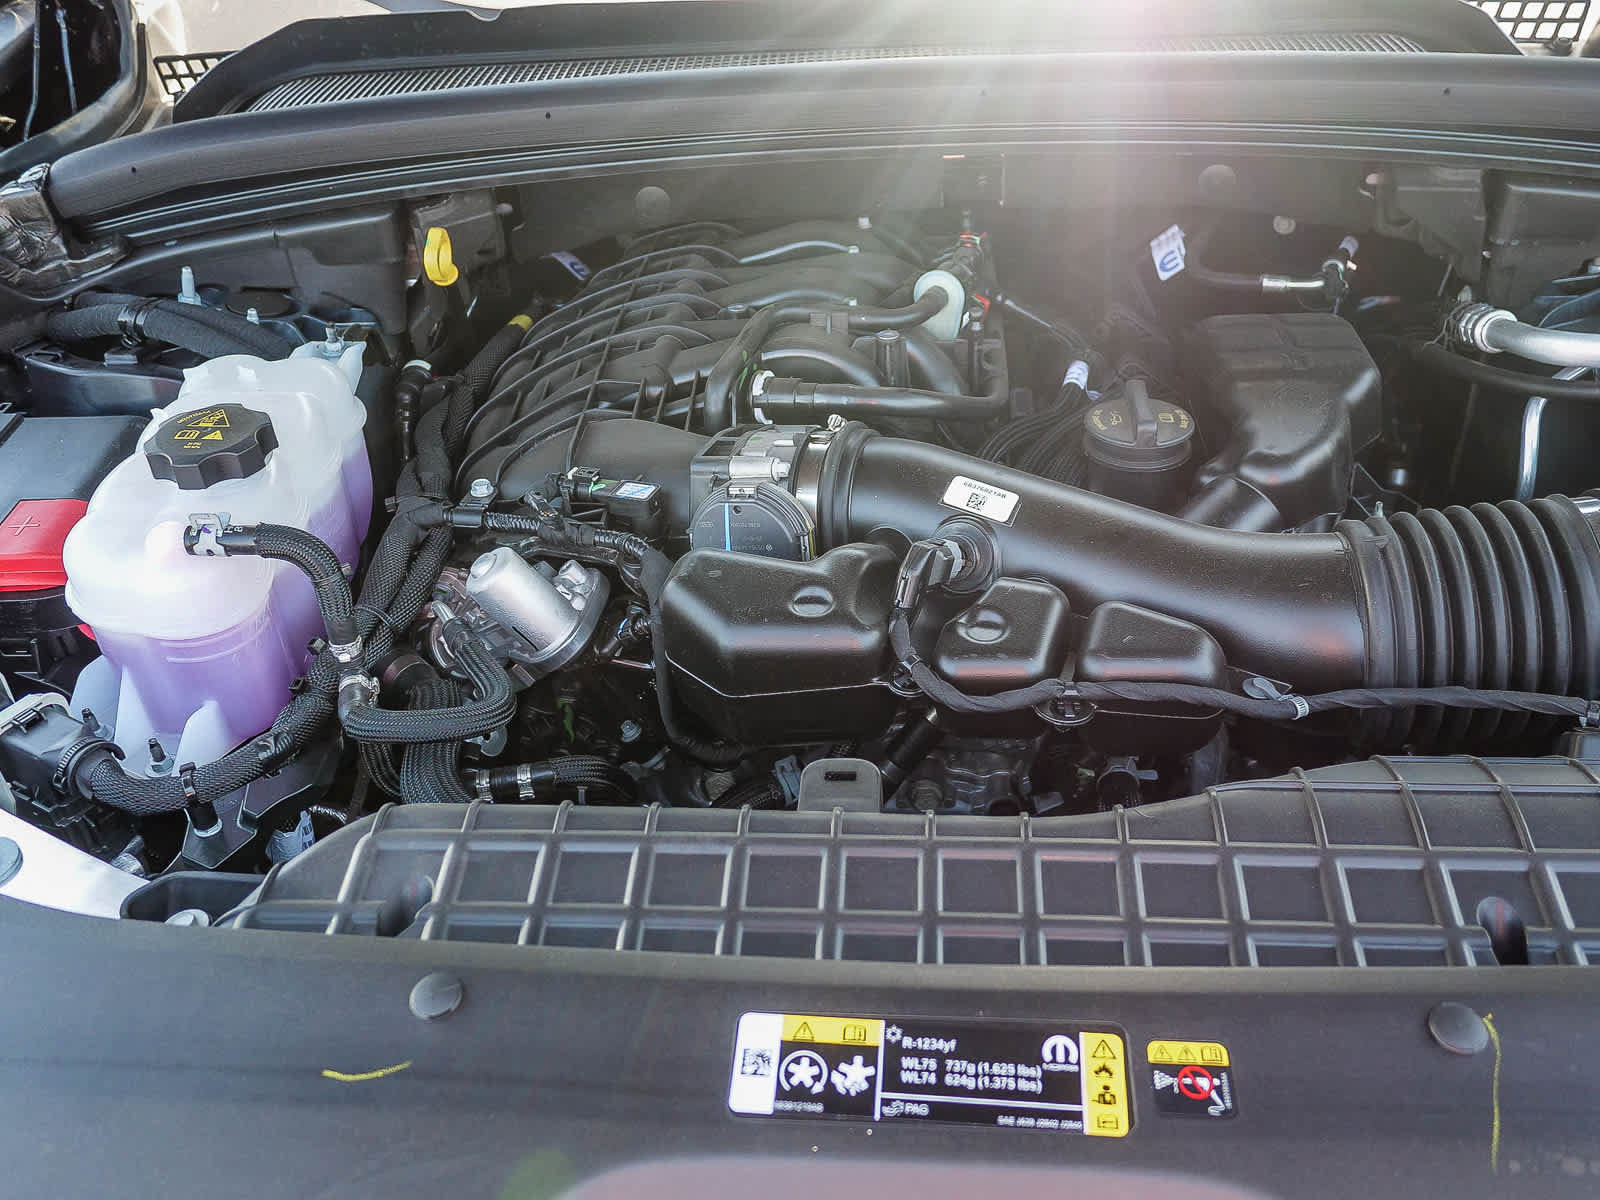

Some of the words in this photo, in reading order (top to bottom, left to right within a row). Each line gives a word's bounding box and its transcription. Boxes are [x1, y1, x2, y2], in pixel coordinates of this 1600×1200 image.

[901, 1036, 957, 1054] R-1234yf
[900, 1056, 937, 1071] WL75
[944, 1059, 976, 1075] 737g
[977, 1061, 1016, 1076] (1.625
[1017, 1063, 1042, 1079] lbs)
[900, 1069, 937, 1084] WL74
[944, 1072, 976, 1089] 624g
[977, 1075, 1016, 1091] (1.375
[1017, 1078, 1043, 1094] lbs)
